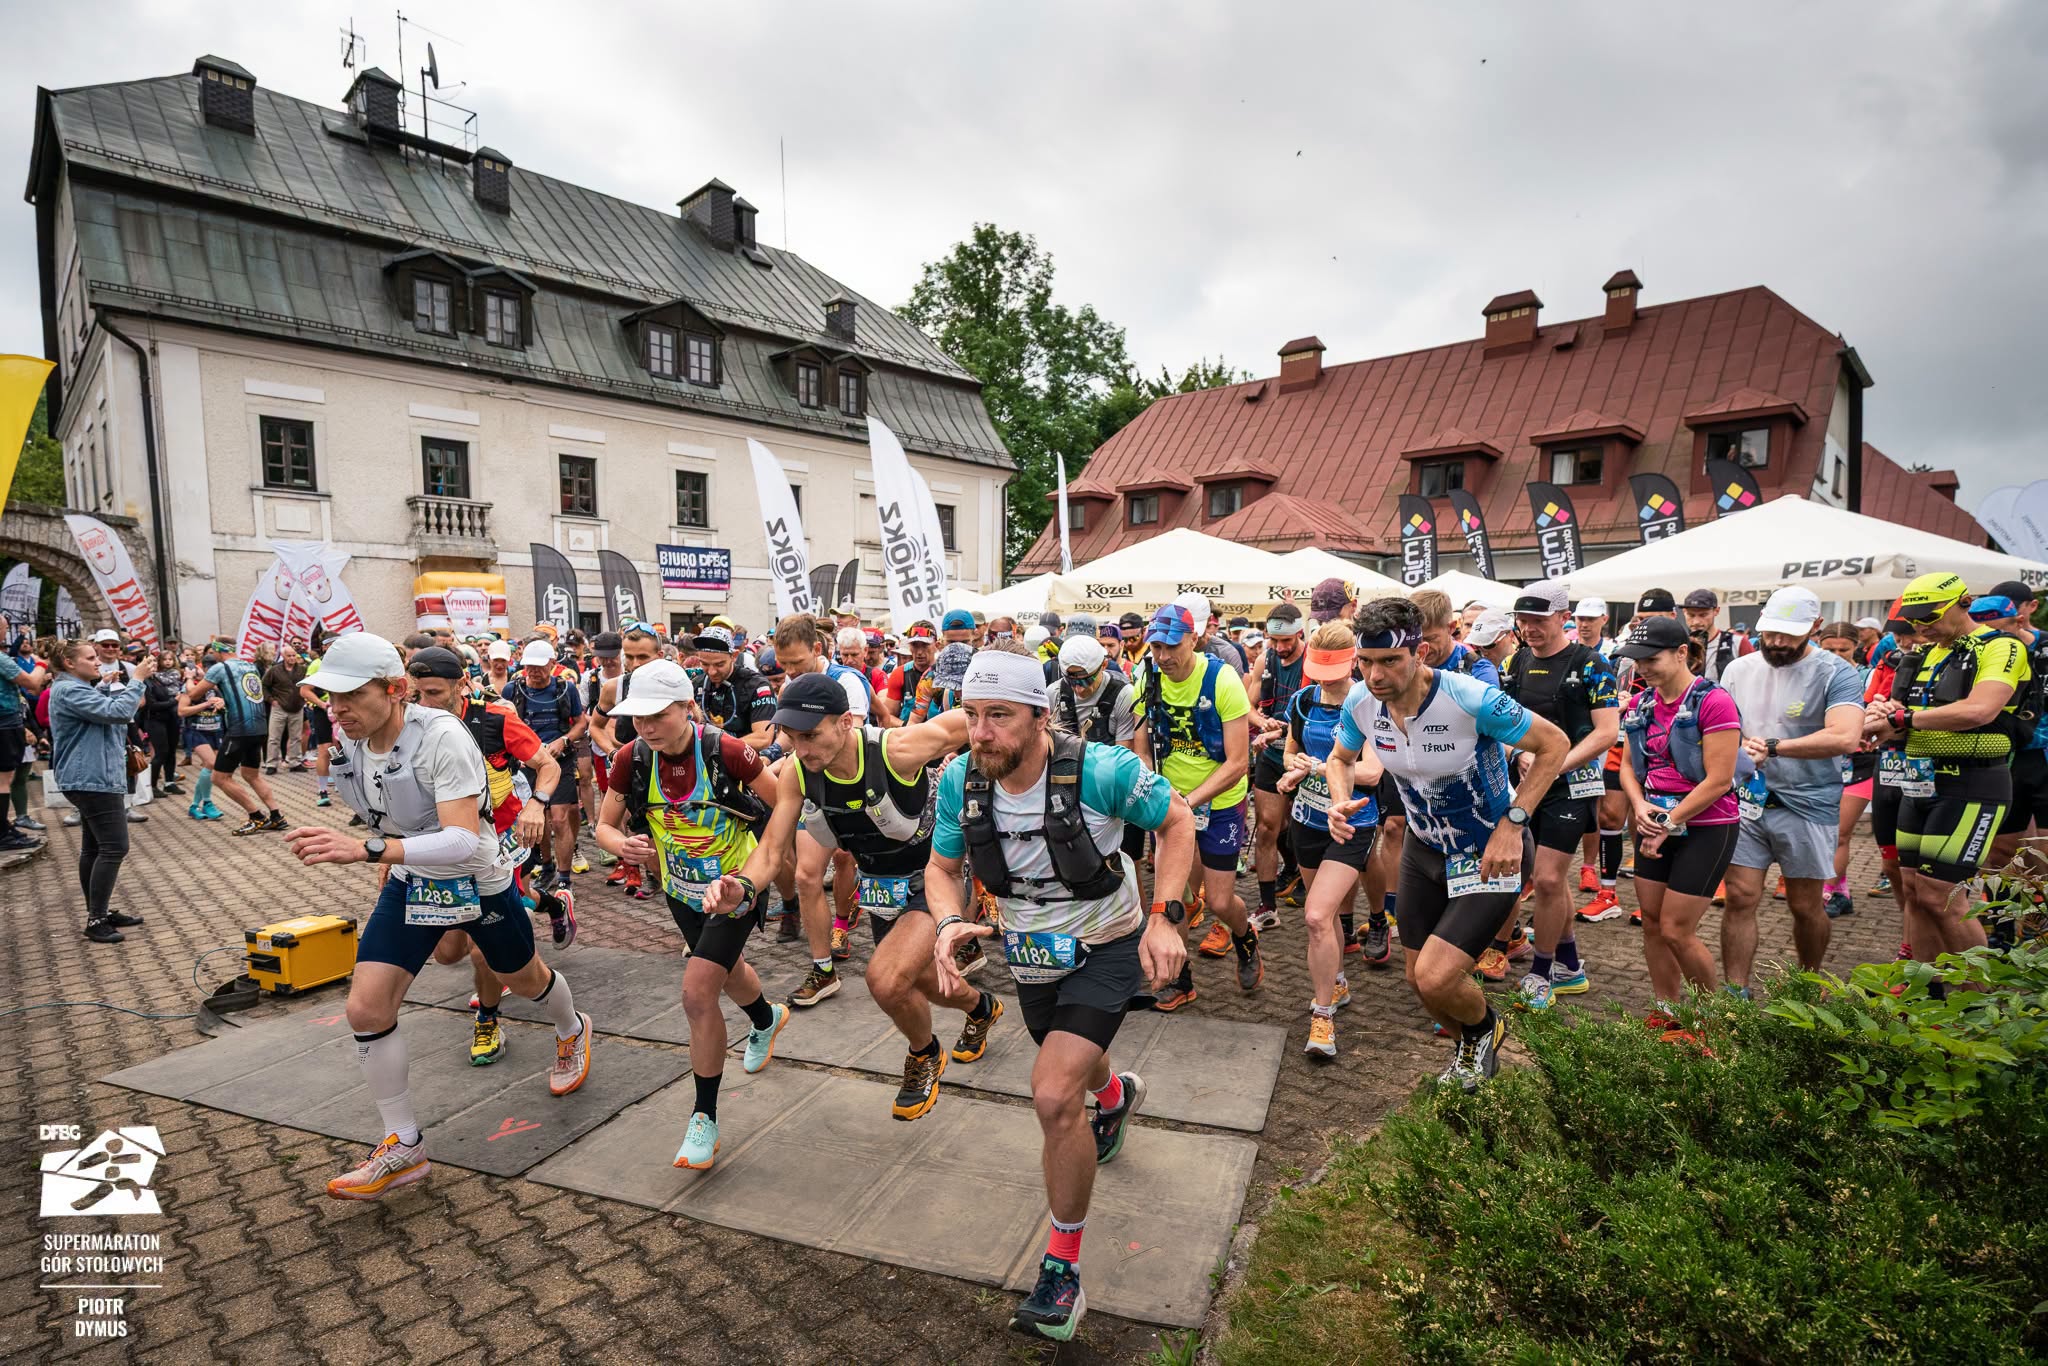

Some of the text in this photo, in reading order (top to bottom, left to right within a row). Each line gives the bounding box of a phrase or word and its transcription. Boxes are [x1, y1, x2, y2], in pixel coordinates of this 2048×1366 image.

[660, 551, 697, 567] BIURO
[1781, 556, 1874, 579] PEPSI
[661, 566, 697, 578] ZAWODÓW
[1086, 584, 1133, 598] Kozel
[1963, 813, 1992, 862] TRITON
[670, 862, 699, 881] 1371
[416, 887, 454, 905] 1283
[865, 889, 890, 904] 1163
[1012, 946, 1053, 966] 1182
